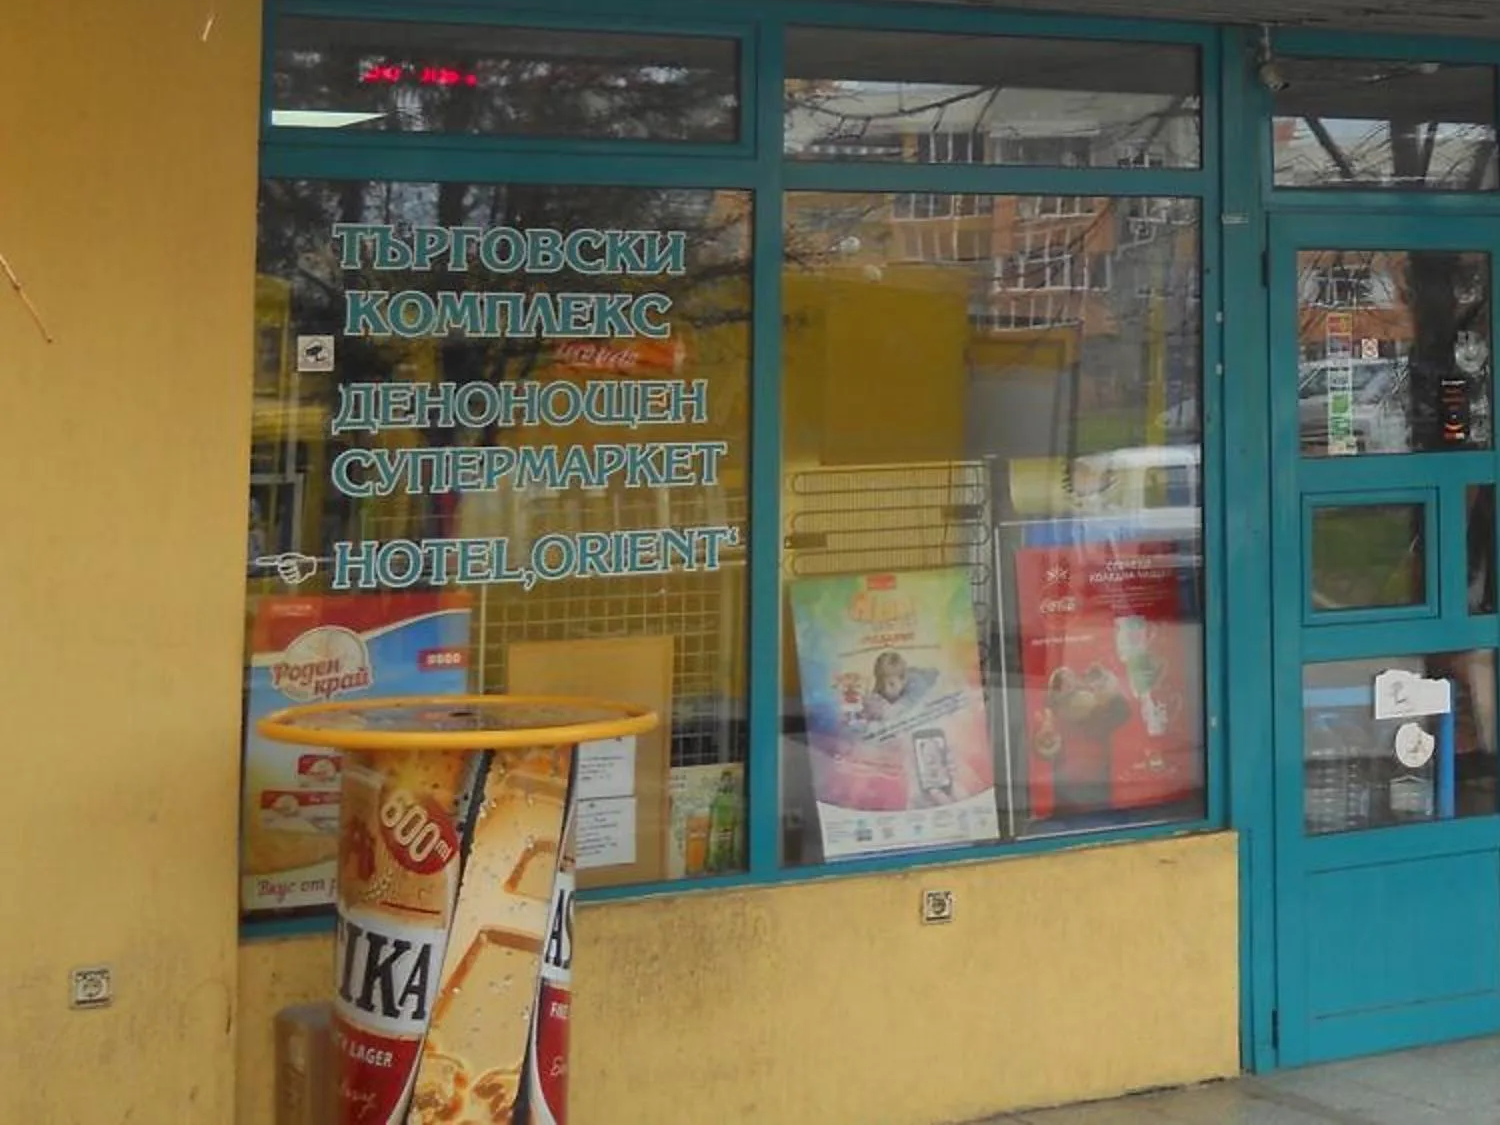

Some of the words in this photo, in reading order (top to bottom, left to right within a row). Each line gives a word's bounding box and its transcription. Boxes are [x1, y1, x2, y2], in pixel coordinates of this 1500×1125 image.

[332, 224, 686, 274] ТЪРГОВСКИ
[344, 291, 672, 338] КОМПЛЕКС
[331, 379, 709, 435] ДЕНОНОЩЕН
[331, 441, 727, 498] СУПЕРМАРКЕТ
[272, 659, 340, 685] Роден
[314, 668, 369, 698] край
[337, 922, 432, 1020] IKA
[349, 1042, 393, 1069] LAGER
